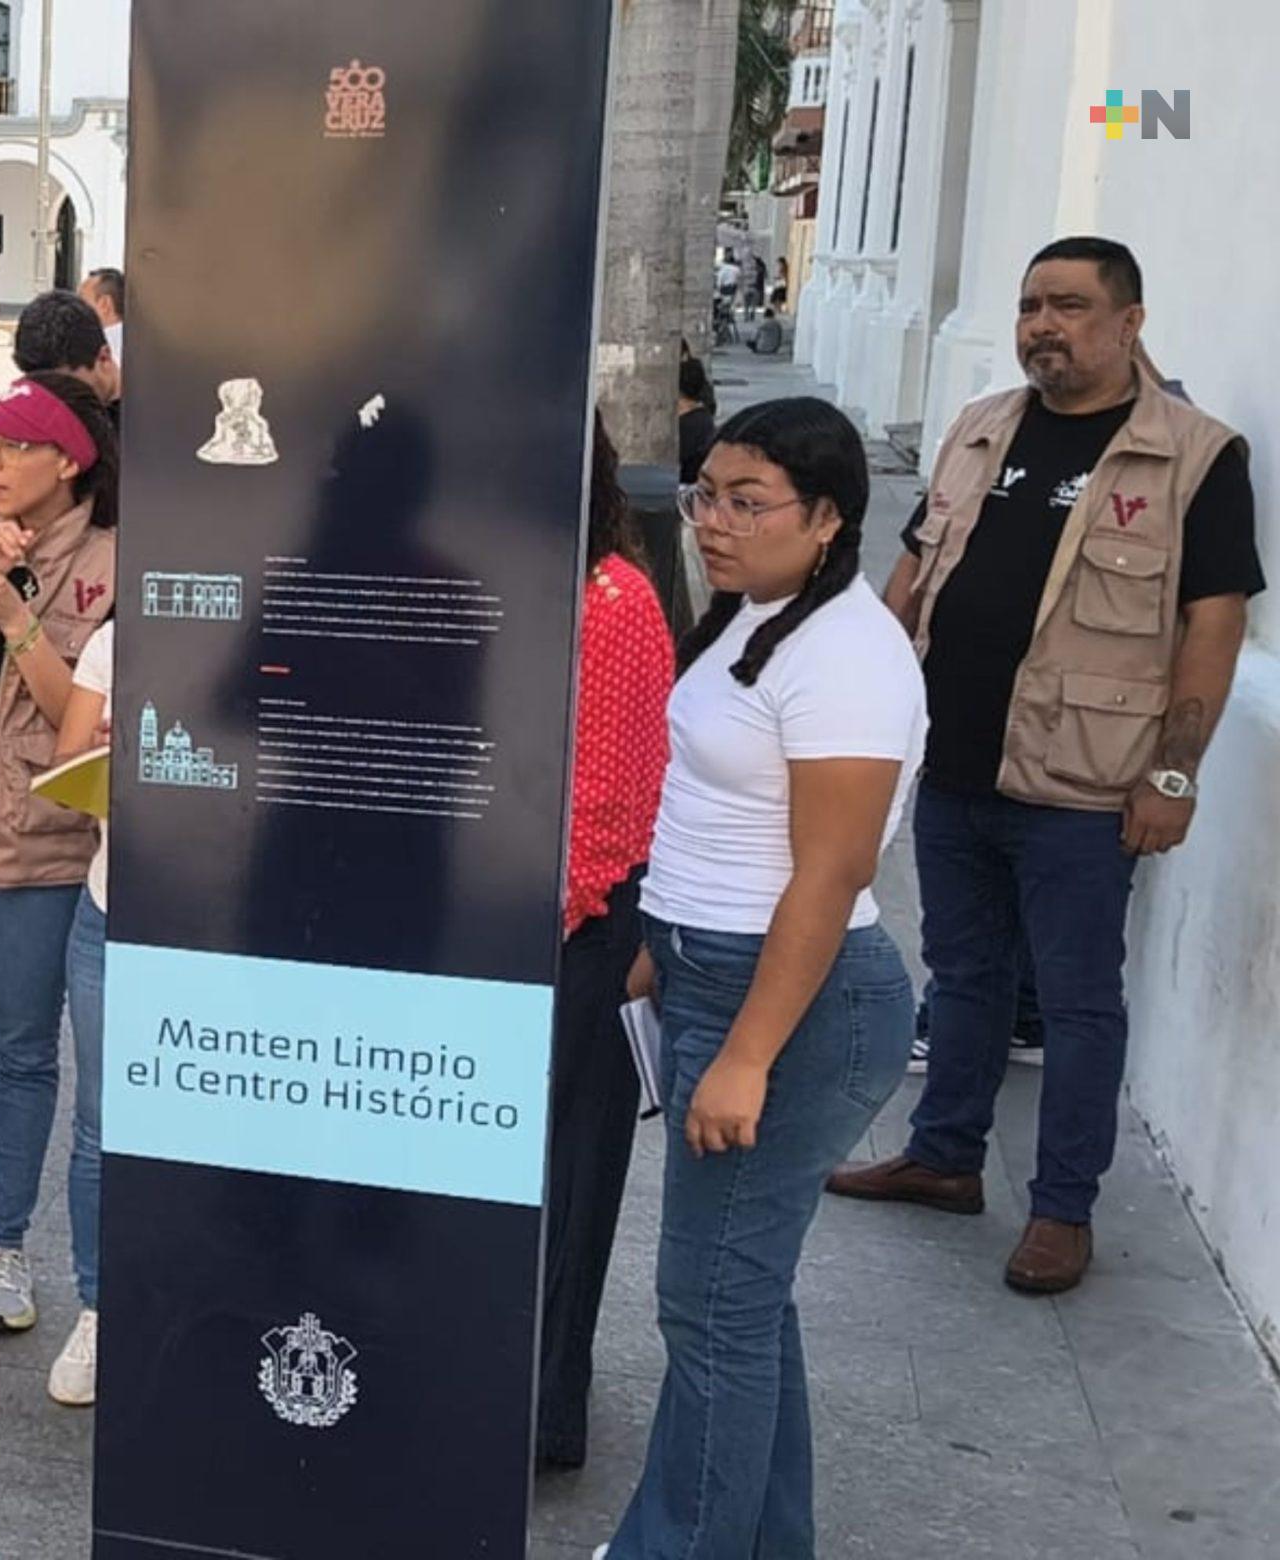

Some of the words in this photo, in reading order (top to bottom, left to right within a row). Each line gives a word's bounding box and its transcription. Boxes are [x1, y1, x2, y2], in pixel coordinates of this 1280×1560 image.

[329, 66, 386, 91] 500
[324, 110, 386, 130] CRUZ
[157, 1017, 319, 1063] Manten
[334, 1036, 477, 1082] Limpio
[126, 1056, 161, 1087] el
[175, 1062, 310, 1105] Centro
[323, 1079, 519, 1129] Histórico
